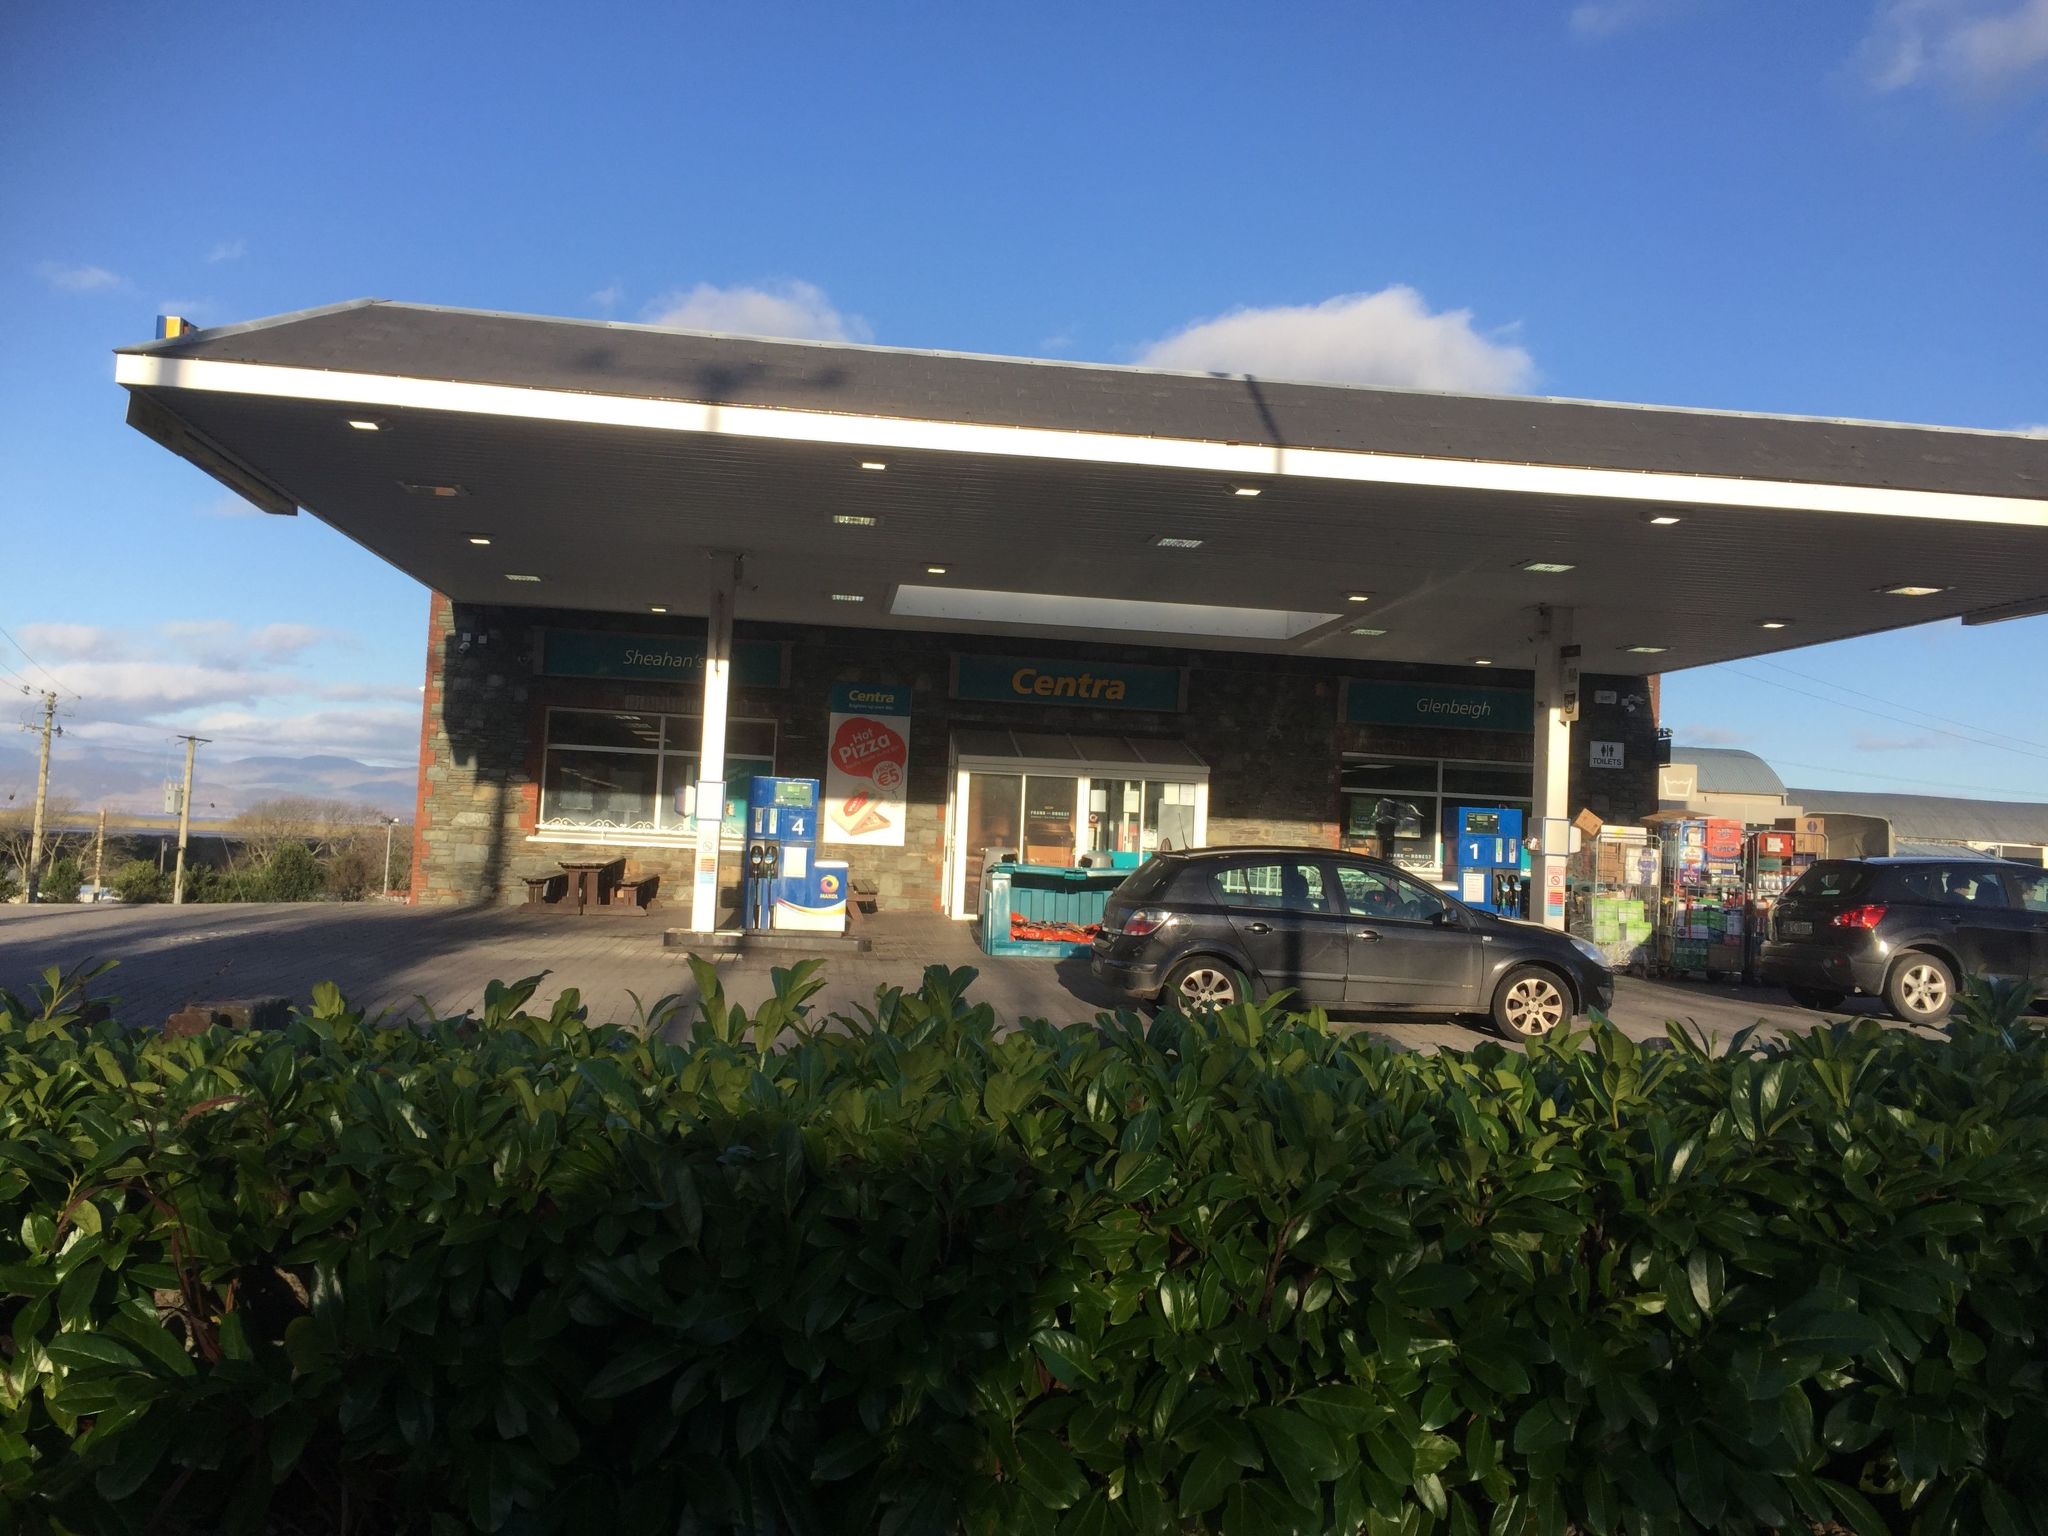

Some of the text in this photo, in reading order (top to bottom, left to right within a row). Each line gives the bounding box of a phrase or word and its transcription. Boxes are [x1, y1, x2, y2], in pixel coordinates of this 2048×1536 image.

[623, 648, 705, 669] Sheahan's
[1011, 667, 1126, 700] Centra
[848, 689, 895, 704] Centra
[1416, 697, 1491, 719] Glenbeigh
[852, 727, 873, 744] Hot
[839, 733, 891, 764] Pizza
[1593, 757, 1622, 766] TOILETS
[877, 767, 900, 786] €5
[791, 817, 805, 836] 4
[1469, 843, 1479, 860] 1
